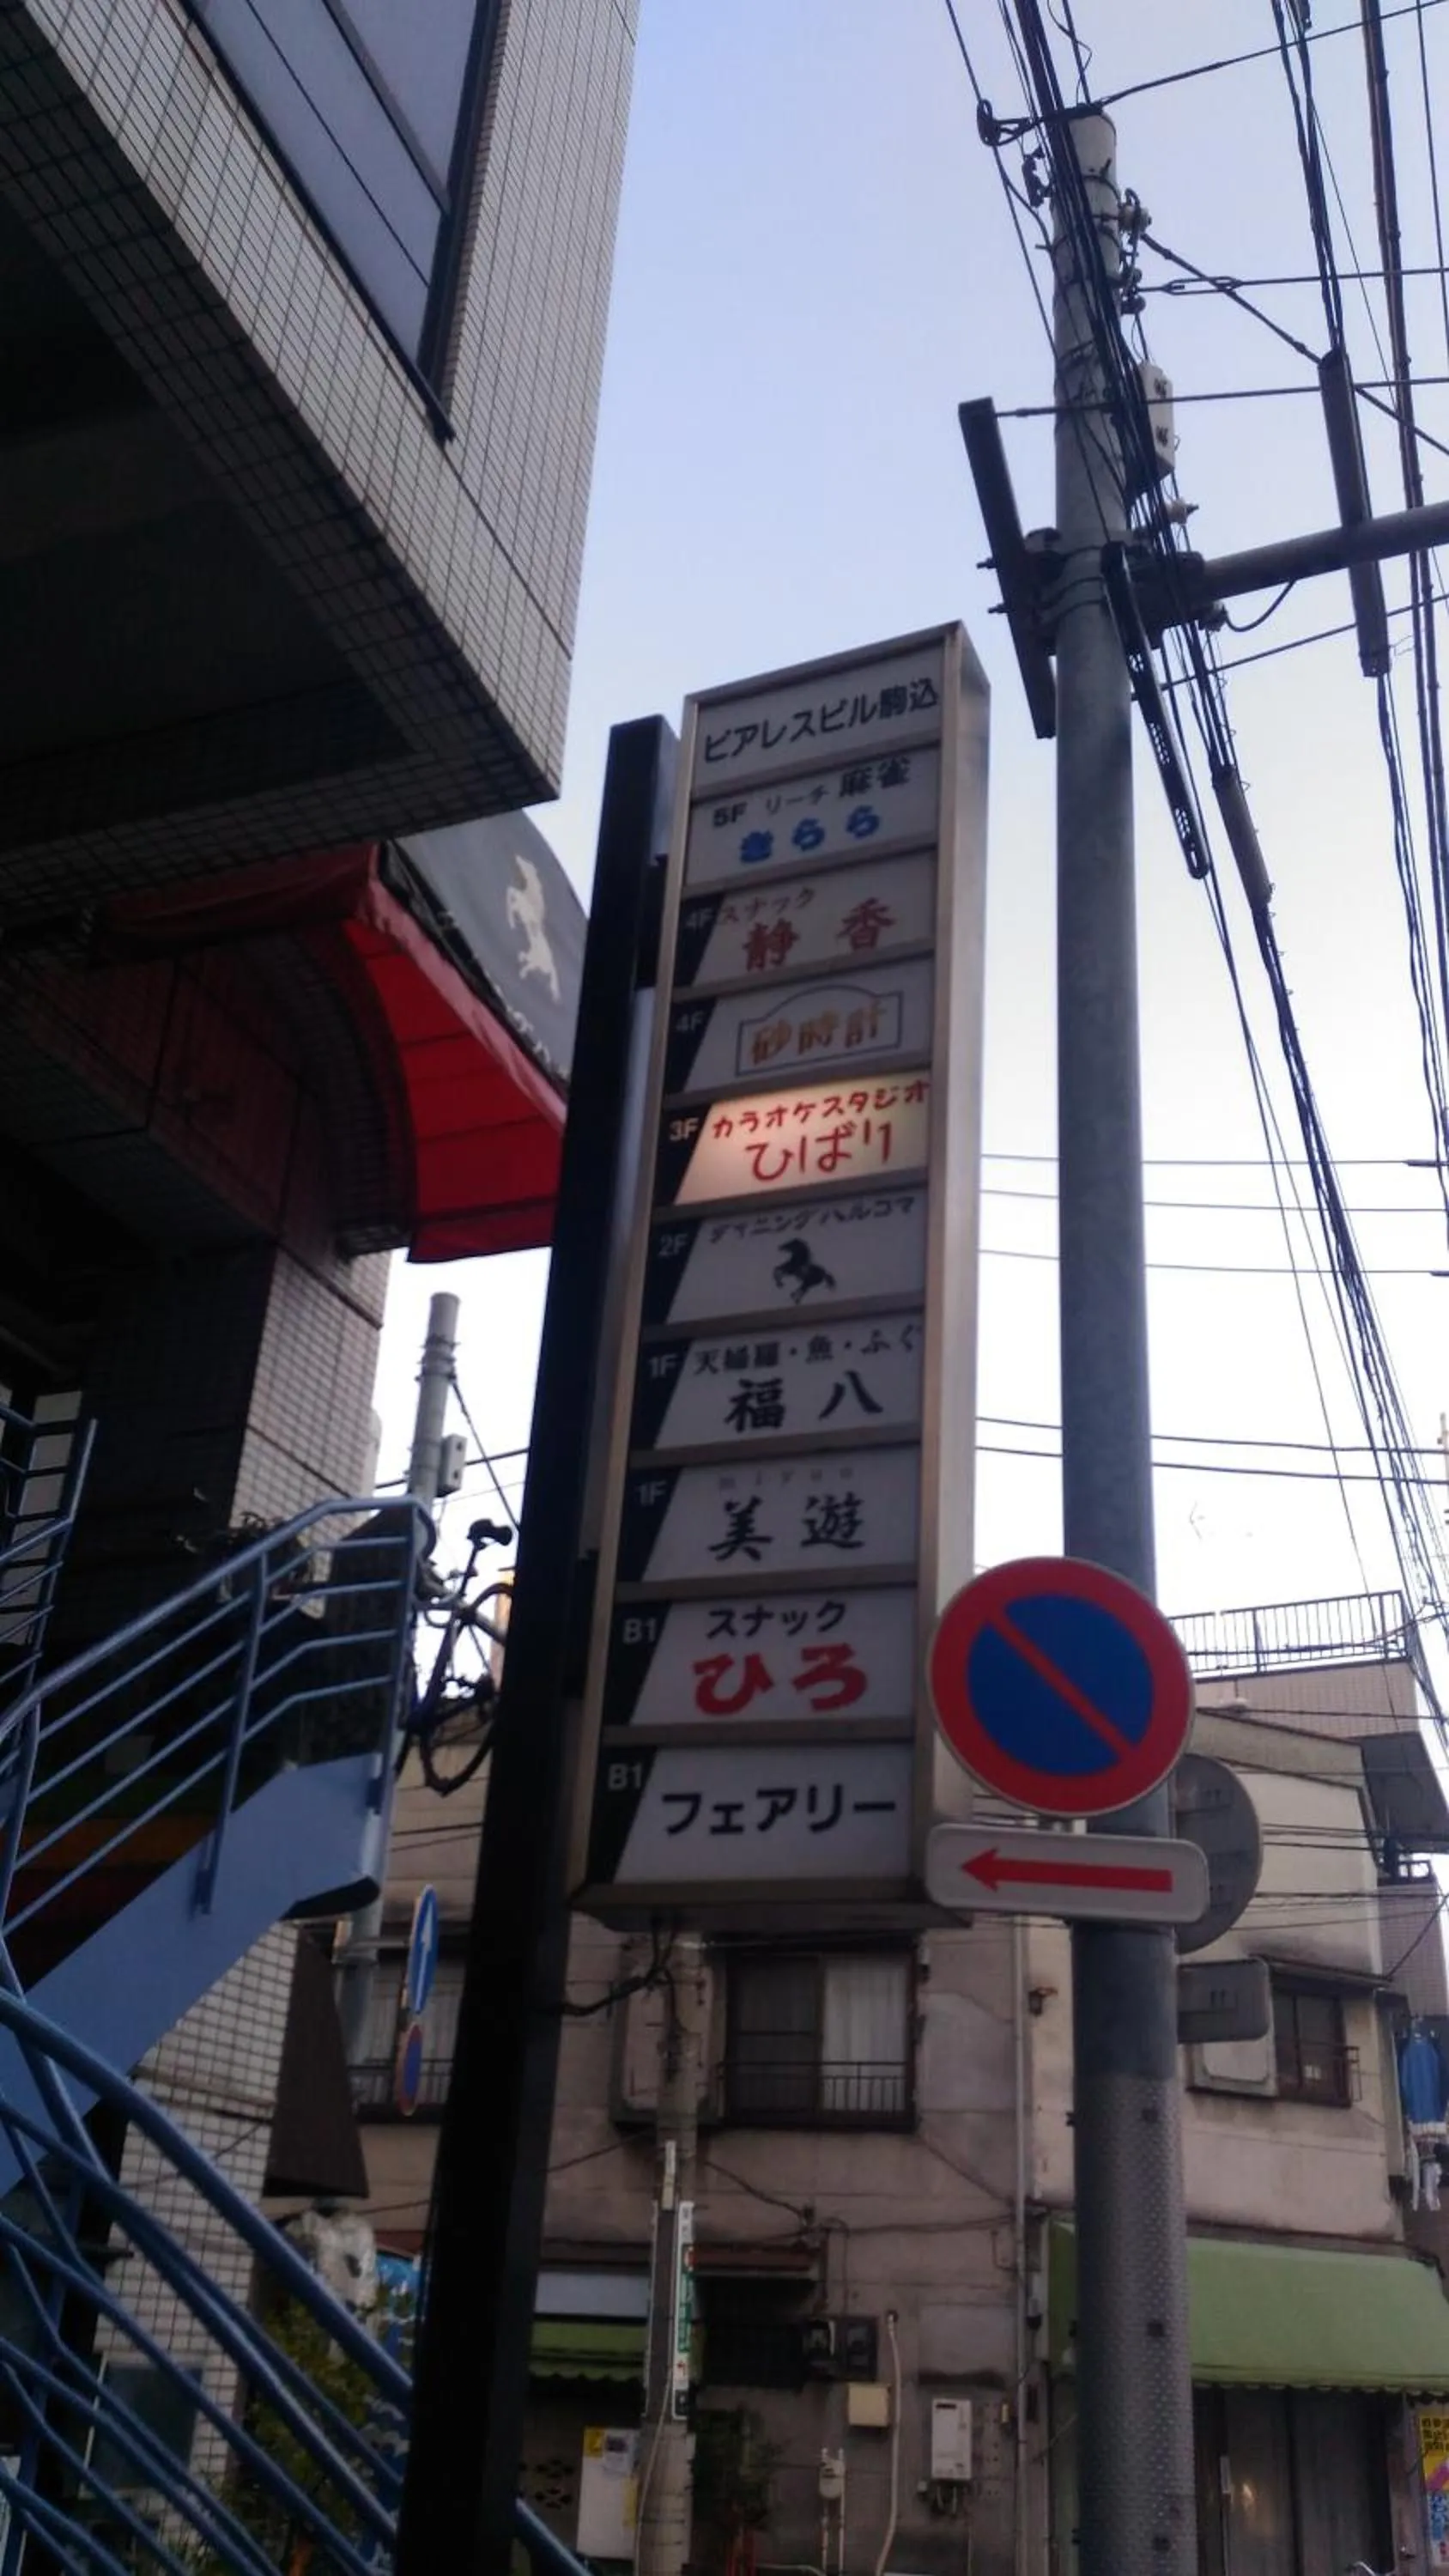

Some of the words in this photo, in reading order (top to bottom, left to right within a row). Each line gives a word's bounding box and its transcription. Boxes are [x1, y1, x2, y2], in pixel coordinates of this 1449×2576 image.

[670, 1118, 700, 1140] 3F
[712, 1079, 931, 1139] カラオケスタジオ
[745, 1120, 892, 1182] ひばり
[649, 1352, 679, 1378] 1F
[724, 1370, 884, 1433] 福八
[638, 1479, 669, 1506] 1F
[708, 1492, 864, 1562] 美遊
[622, 1618, 657, 1644] B1
[706, 1601, 846, 1638] スナック
[693, 1642, 869, 1716] ひろ
[608, 1763, 642, 1790] B1
[662, 1783, 896, 1836] フェアリー
